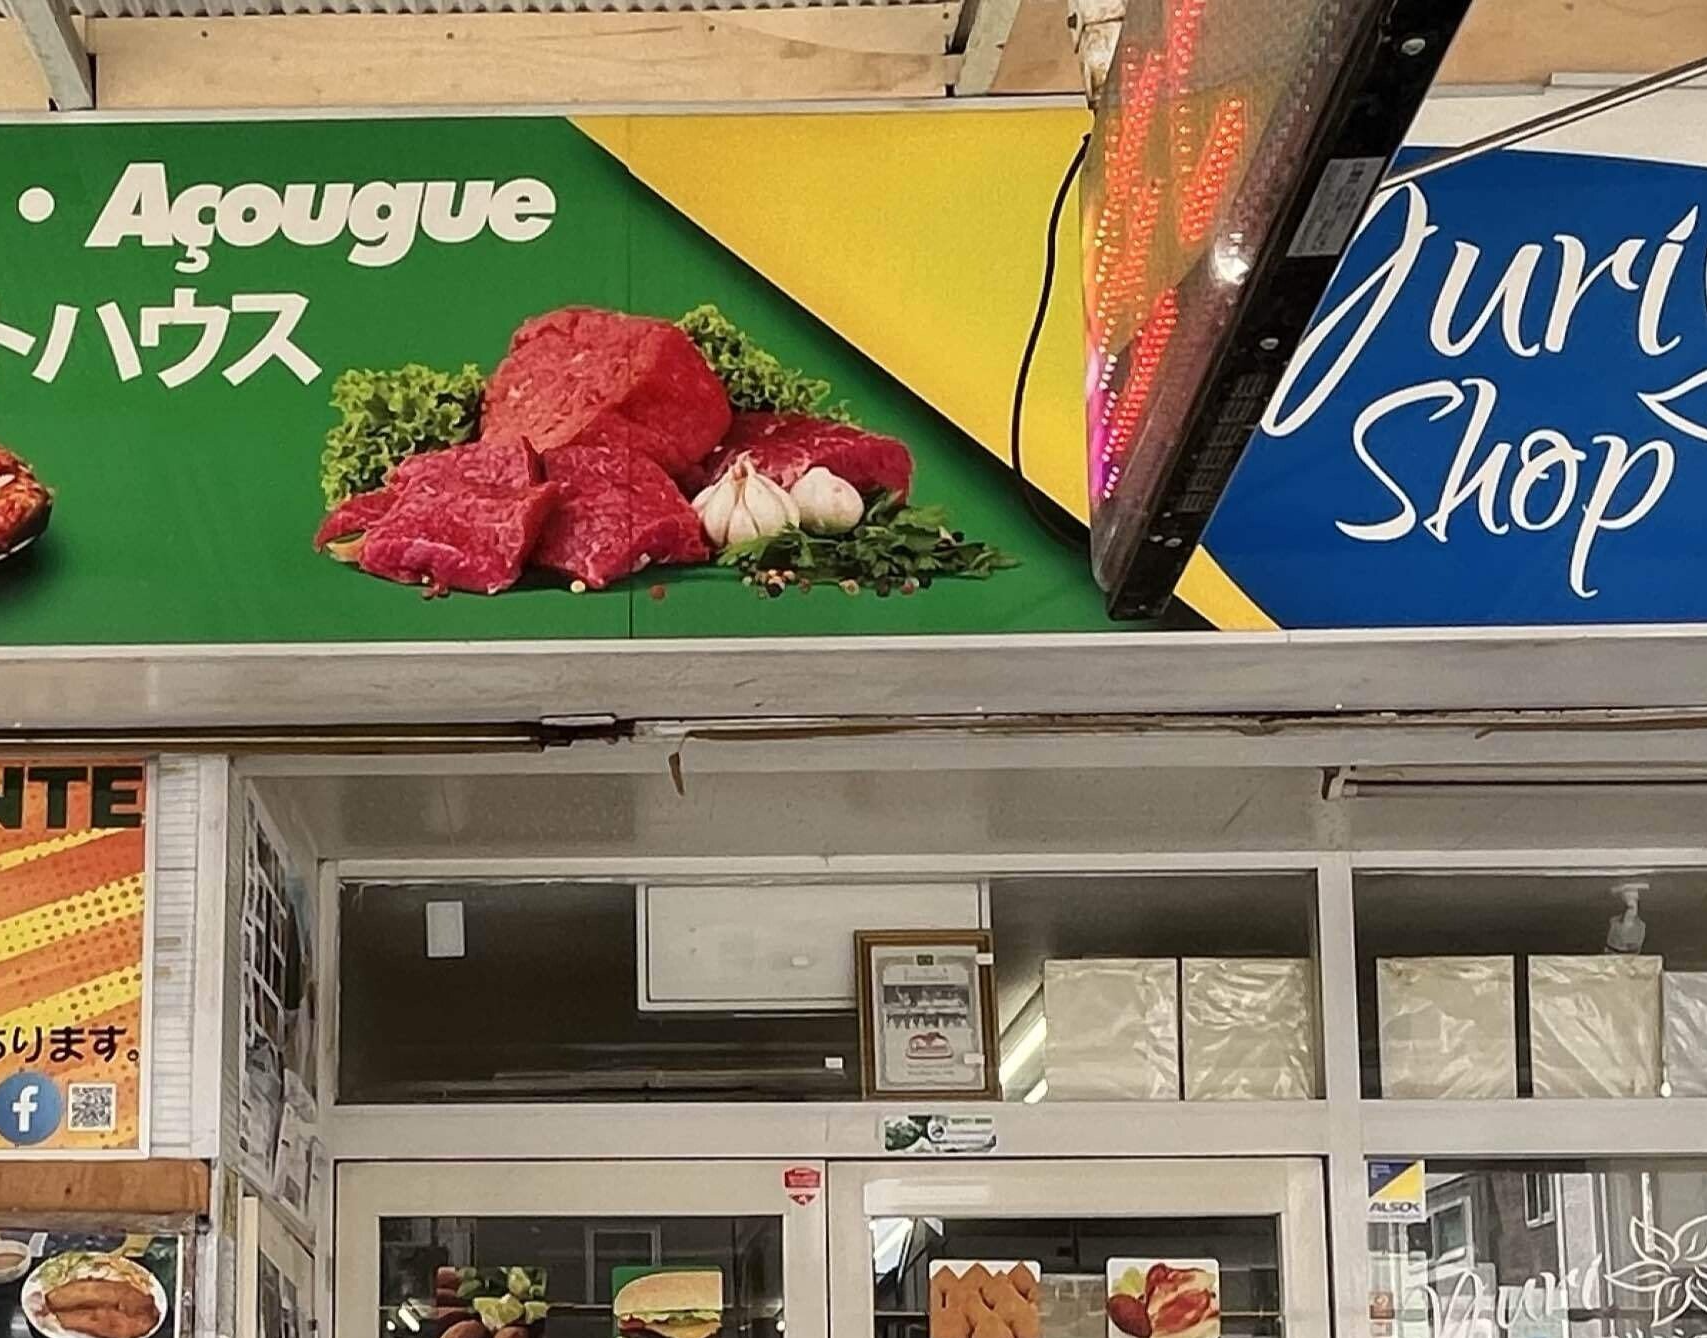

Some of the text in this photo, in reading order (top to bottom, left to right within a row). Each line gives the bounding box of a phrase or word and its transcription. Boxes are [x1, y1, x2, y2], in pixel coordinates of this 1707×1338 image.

[85, 162, 556, 273] Açougue
[1335, 377, 1675, 598] Shop
[1369, 1201, 1421, 1213] ALSOK
